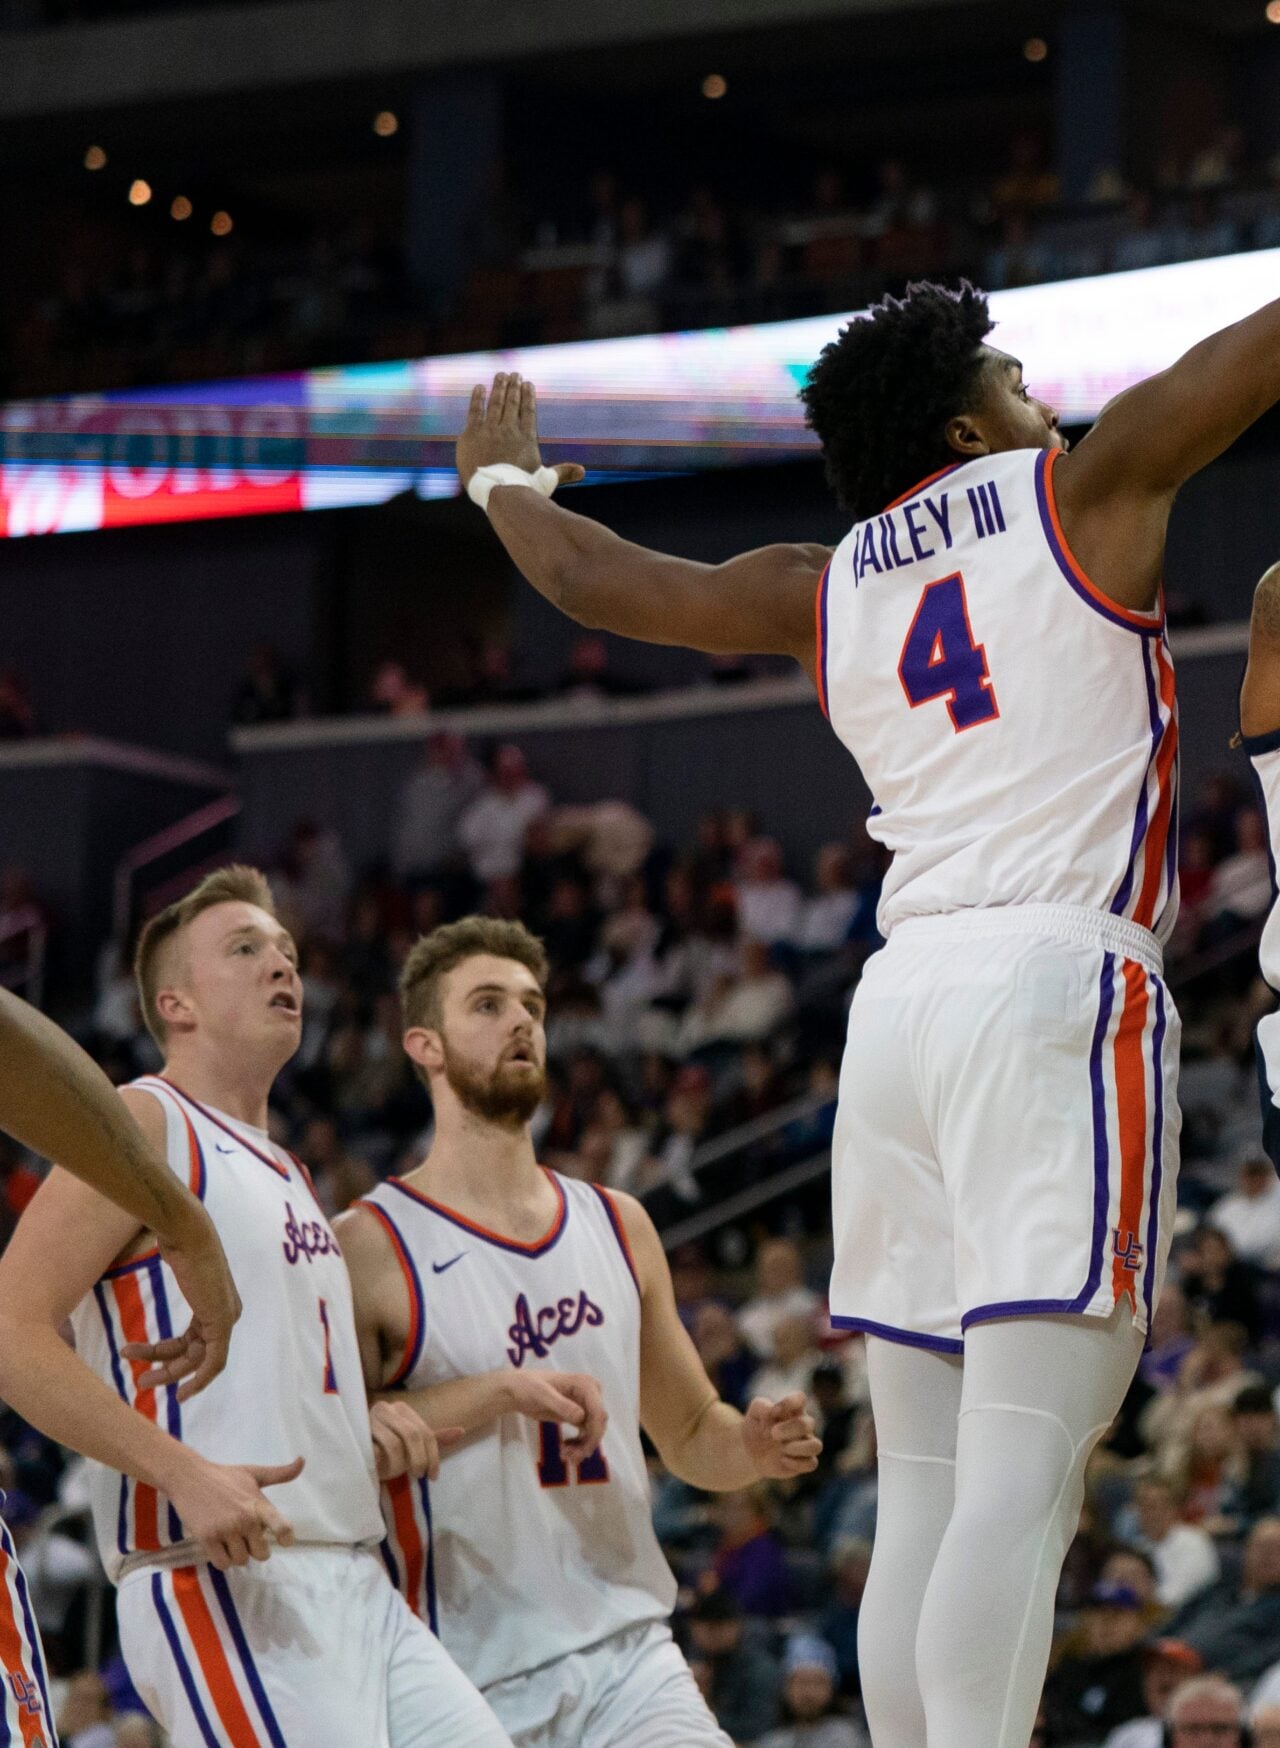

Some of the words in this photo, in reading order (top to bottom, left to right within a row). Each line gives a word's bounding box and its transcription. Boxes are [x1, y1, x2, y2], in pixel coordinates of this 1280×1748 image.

[852, 493, 953, 587] AILEY
[966, 480, 1006, 539] III
[897, 571, 1000, 734] 4
[319, 1297, 339, 1394] 1
[506, 1290, 604, 1368] Aces
